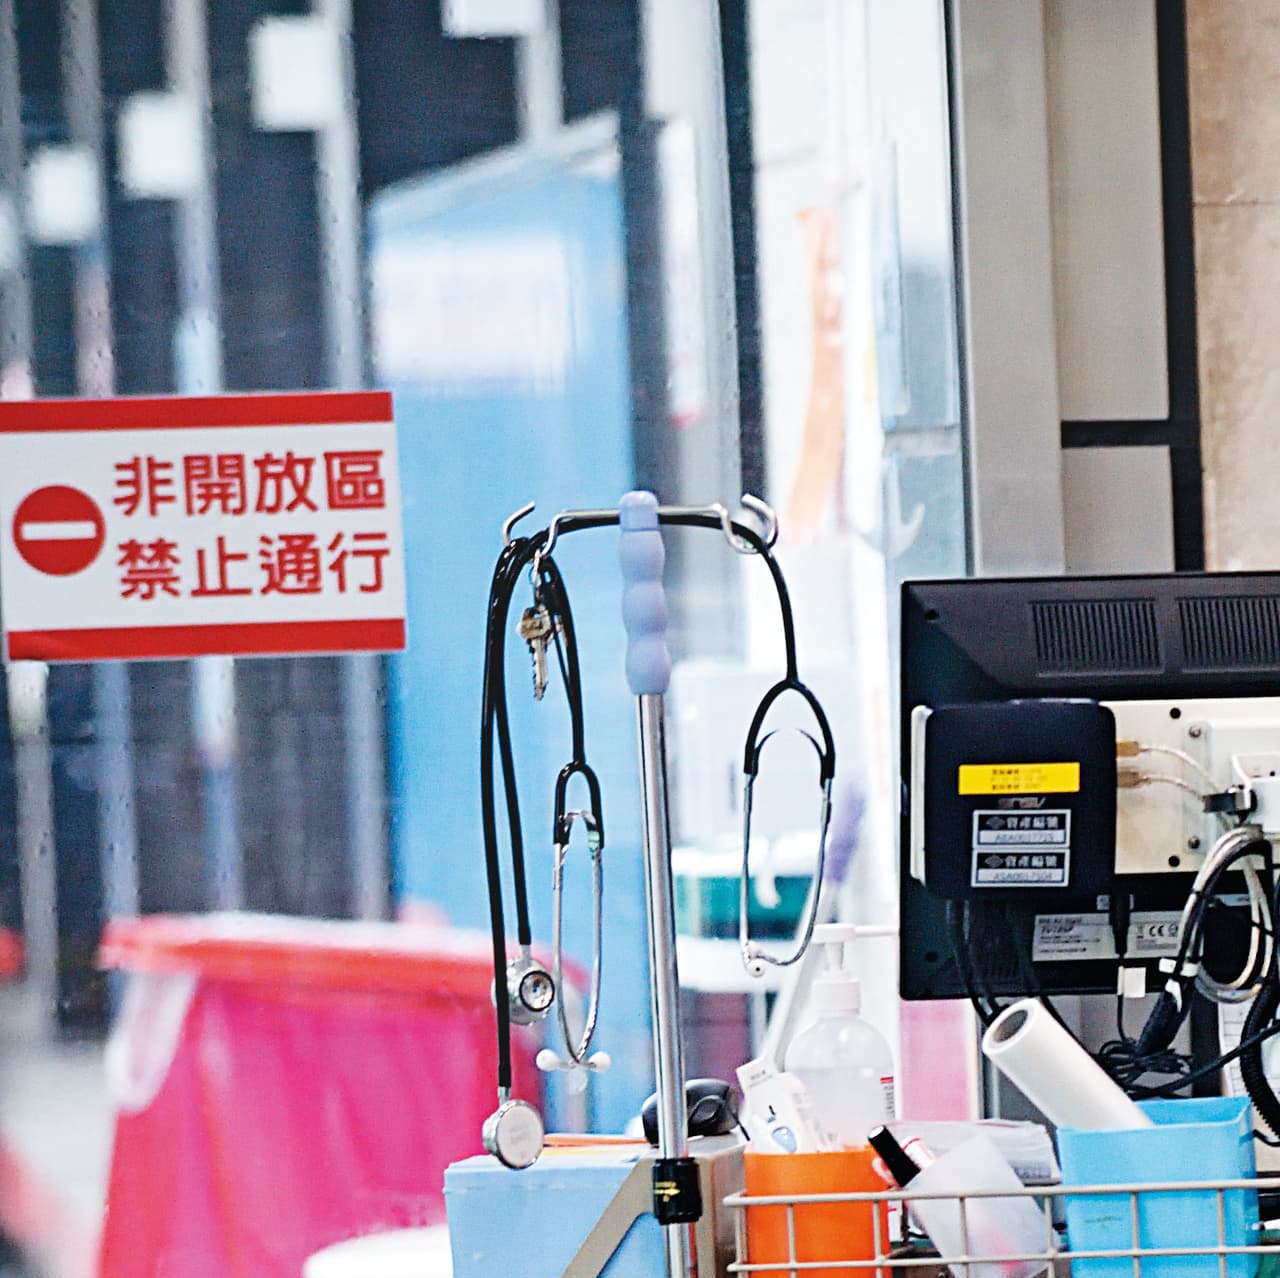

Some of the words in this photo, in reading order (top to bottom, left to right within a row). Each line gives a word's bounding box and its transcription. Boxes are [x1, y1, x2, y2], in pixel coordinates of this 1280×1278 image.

[113, 449, 387, 517] 非開放區
[117, 532, 390, 601] 禁止通行
